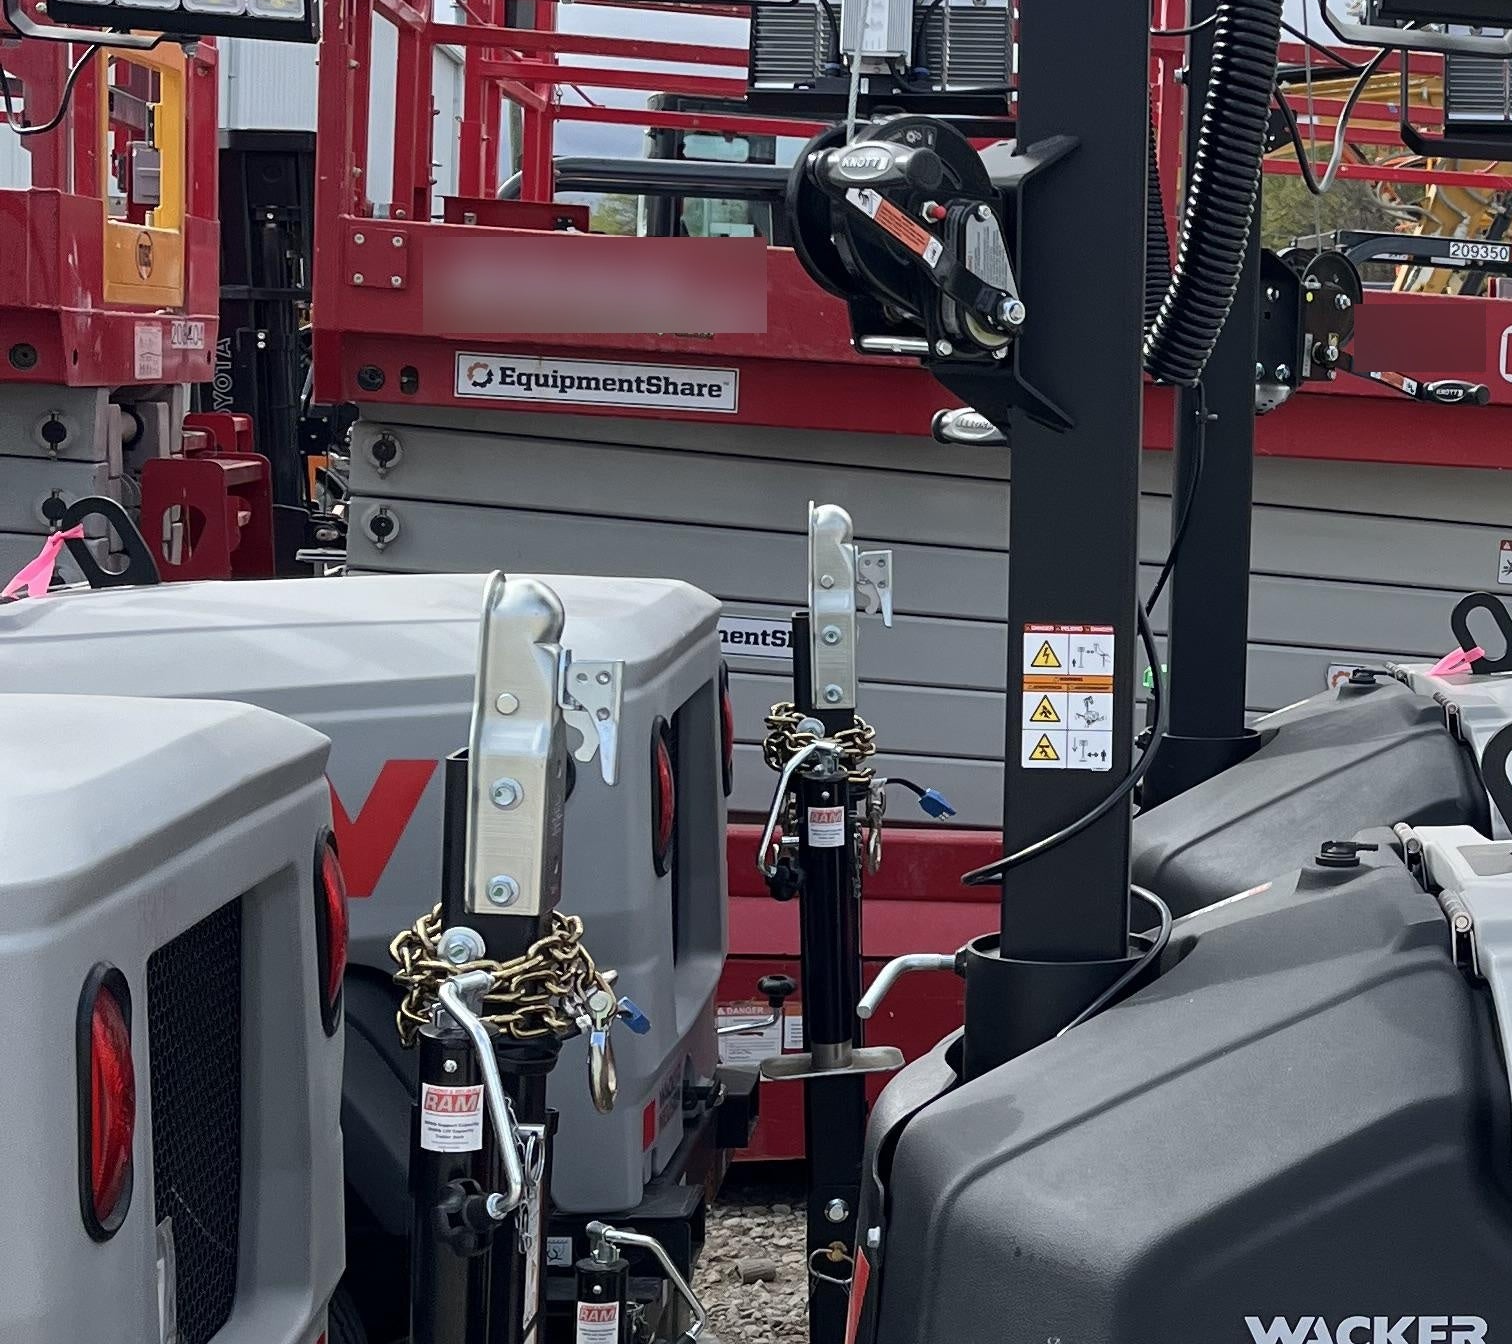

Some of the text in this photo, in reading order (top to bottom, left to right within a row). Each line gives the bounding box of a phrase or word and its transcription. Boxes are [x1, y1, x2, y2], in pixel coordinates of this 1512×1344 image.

[841, 157, 879, 169] KNOTT
[1451, 243, 1508, 260] 209350
[498, 366, 723, 398] EquipmentShare
[726, 1006, 765, 1015] DANGER
[425, 1094, 479, 1112] RAM
[580, 1308, 616, 1322] RAM
